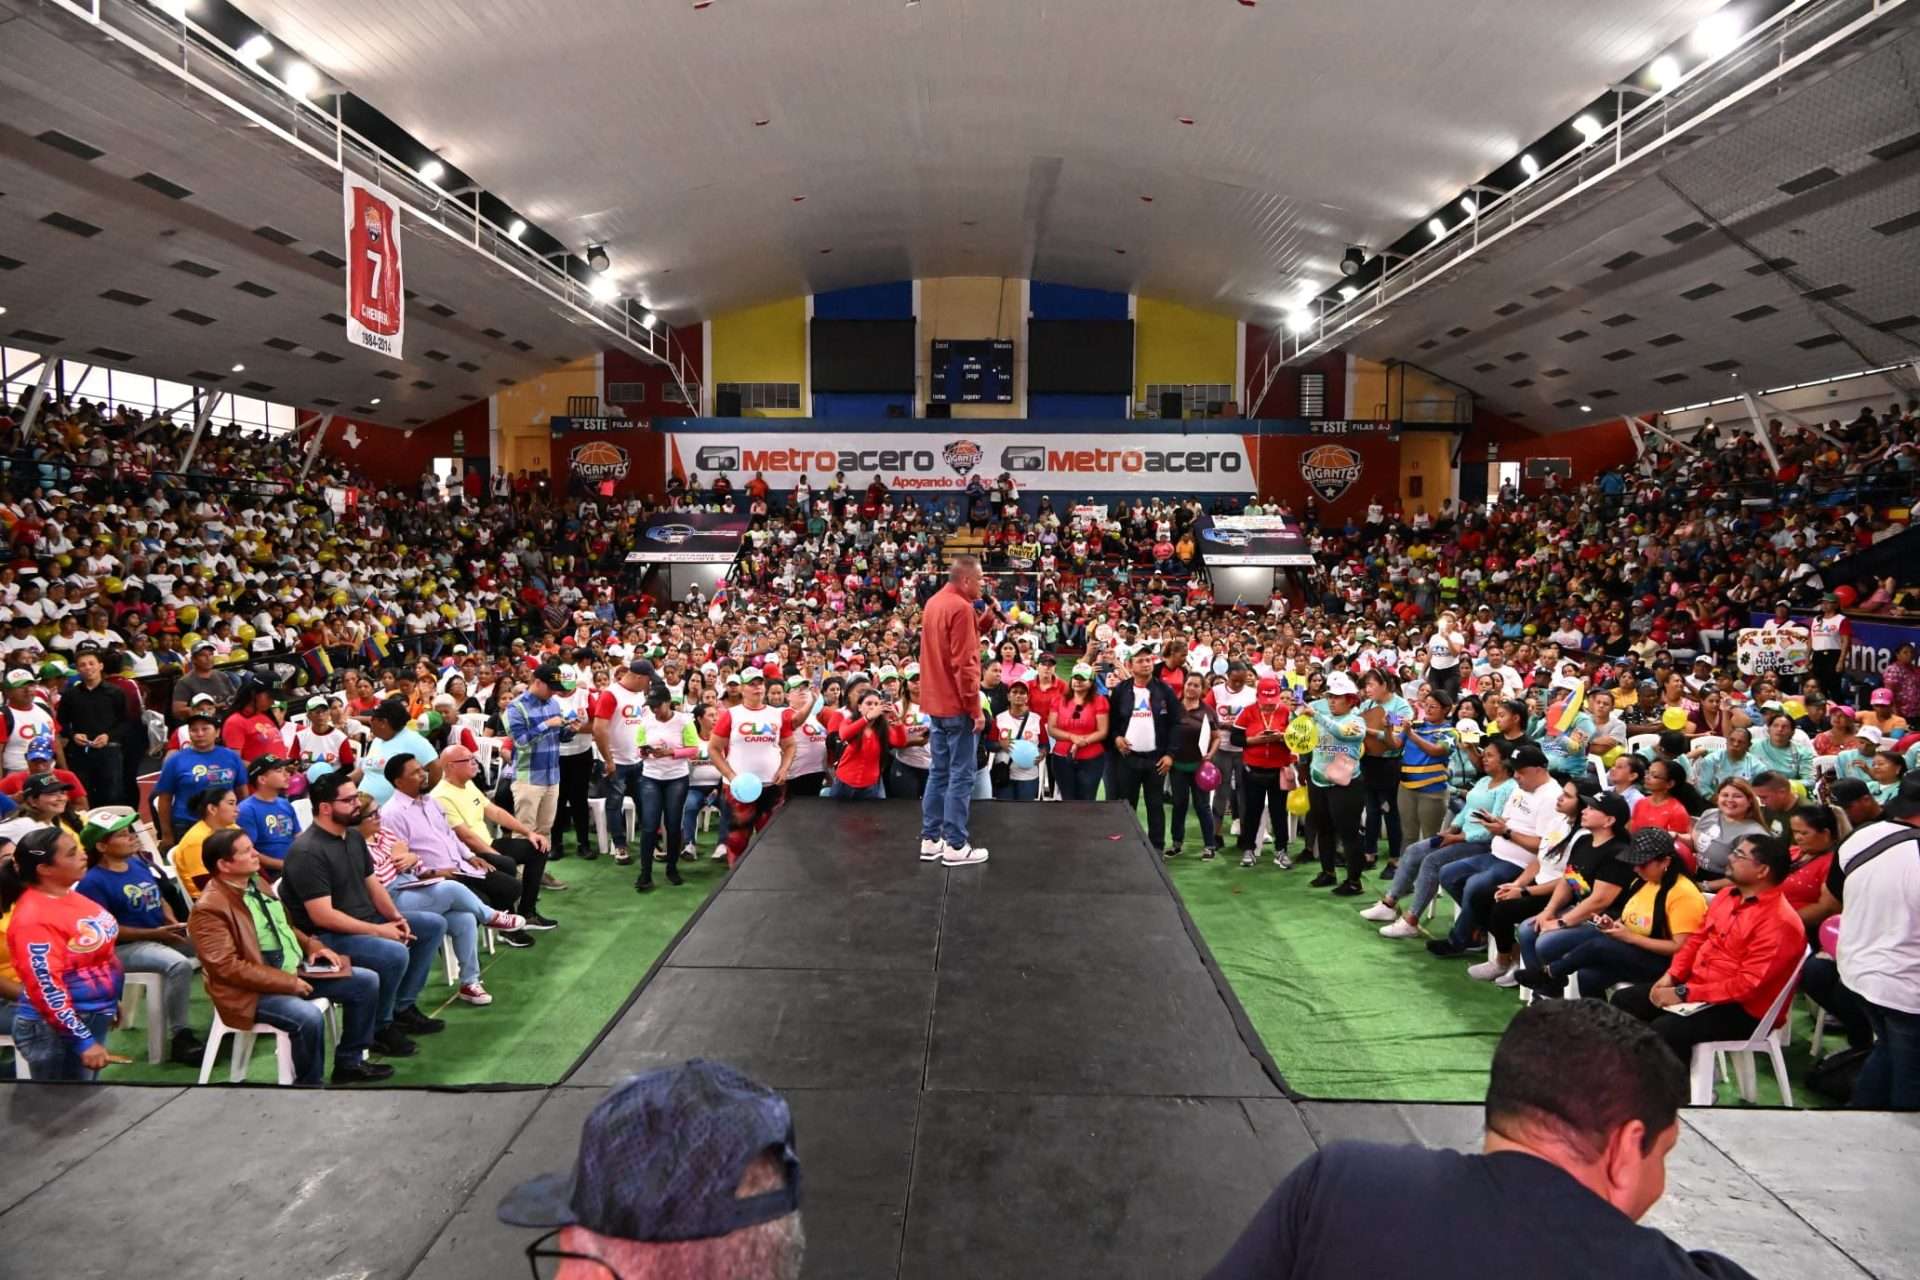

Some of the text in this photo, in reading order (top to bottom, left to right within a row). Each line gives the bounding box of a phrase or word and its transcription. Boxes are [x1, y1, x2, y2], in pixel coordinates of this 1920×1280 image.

[367, 249, 382, 299] 7
[583, 418, 608, 430] ESTE
[1323, 421, 1348, 432] ESTE
[1302, 464, 1361, 481] GIGANTES
[892, 476, 953, 488] Apoyando
[738, 722, 778, 736] CLAP
[27, 942, 67, 1011] Desarrollo
